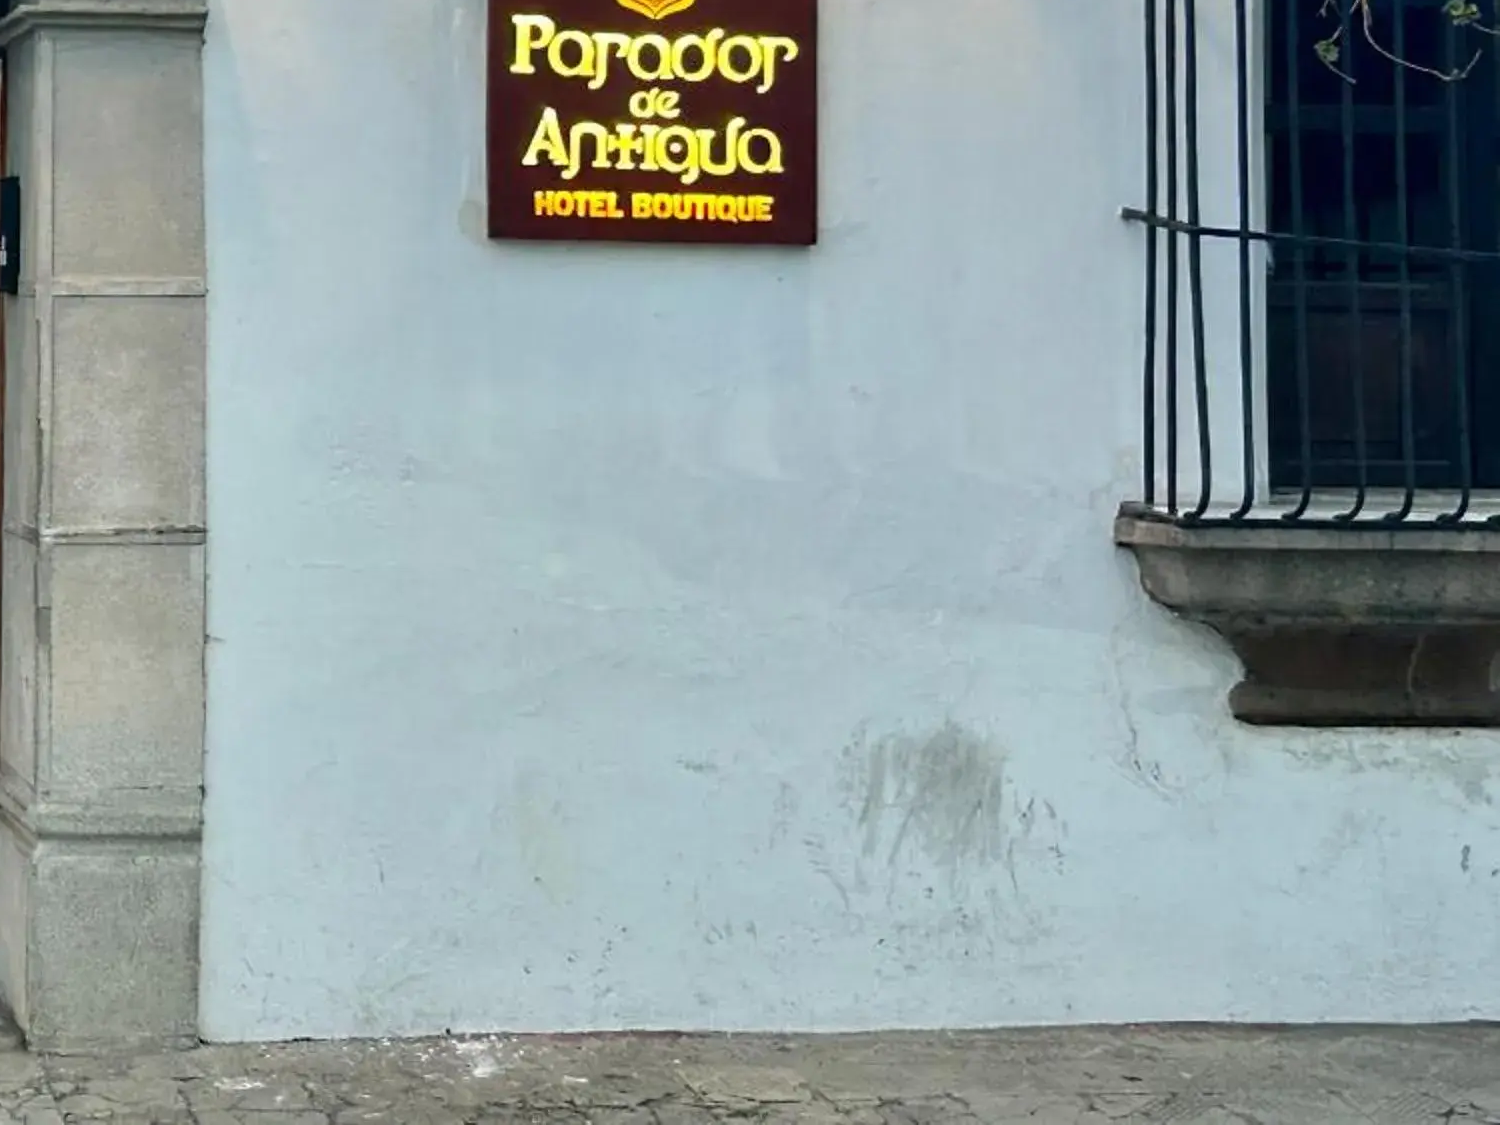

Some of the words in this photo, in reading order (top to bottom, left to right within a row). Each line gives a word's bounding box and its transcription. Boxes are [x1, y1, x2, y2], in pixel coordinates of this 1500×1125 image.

[509, 14, 799, 93] Parador
[628, 86, 681, 118] de
[521, 106, 785, 185] Antigua
[534, 190, 624, 218] HOTEL
[631, 192, 774, 222] BOUTIQUE
